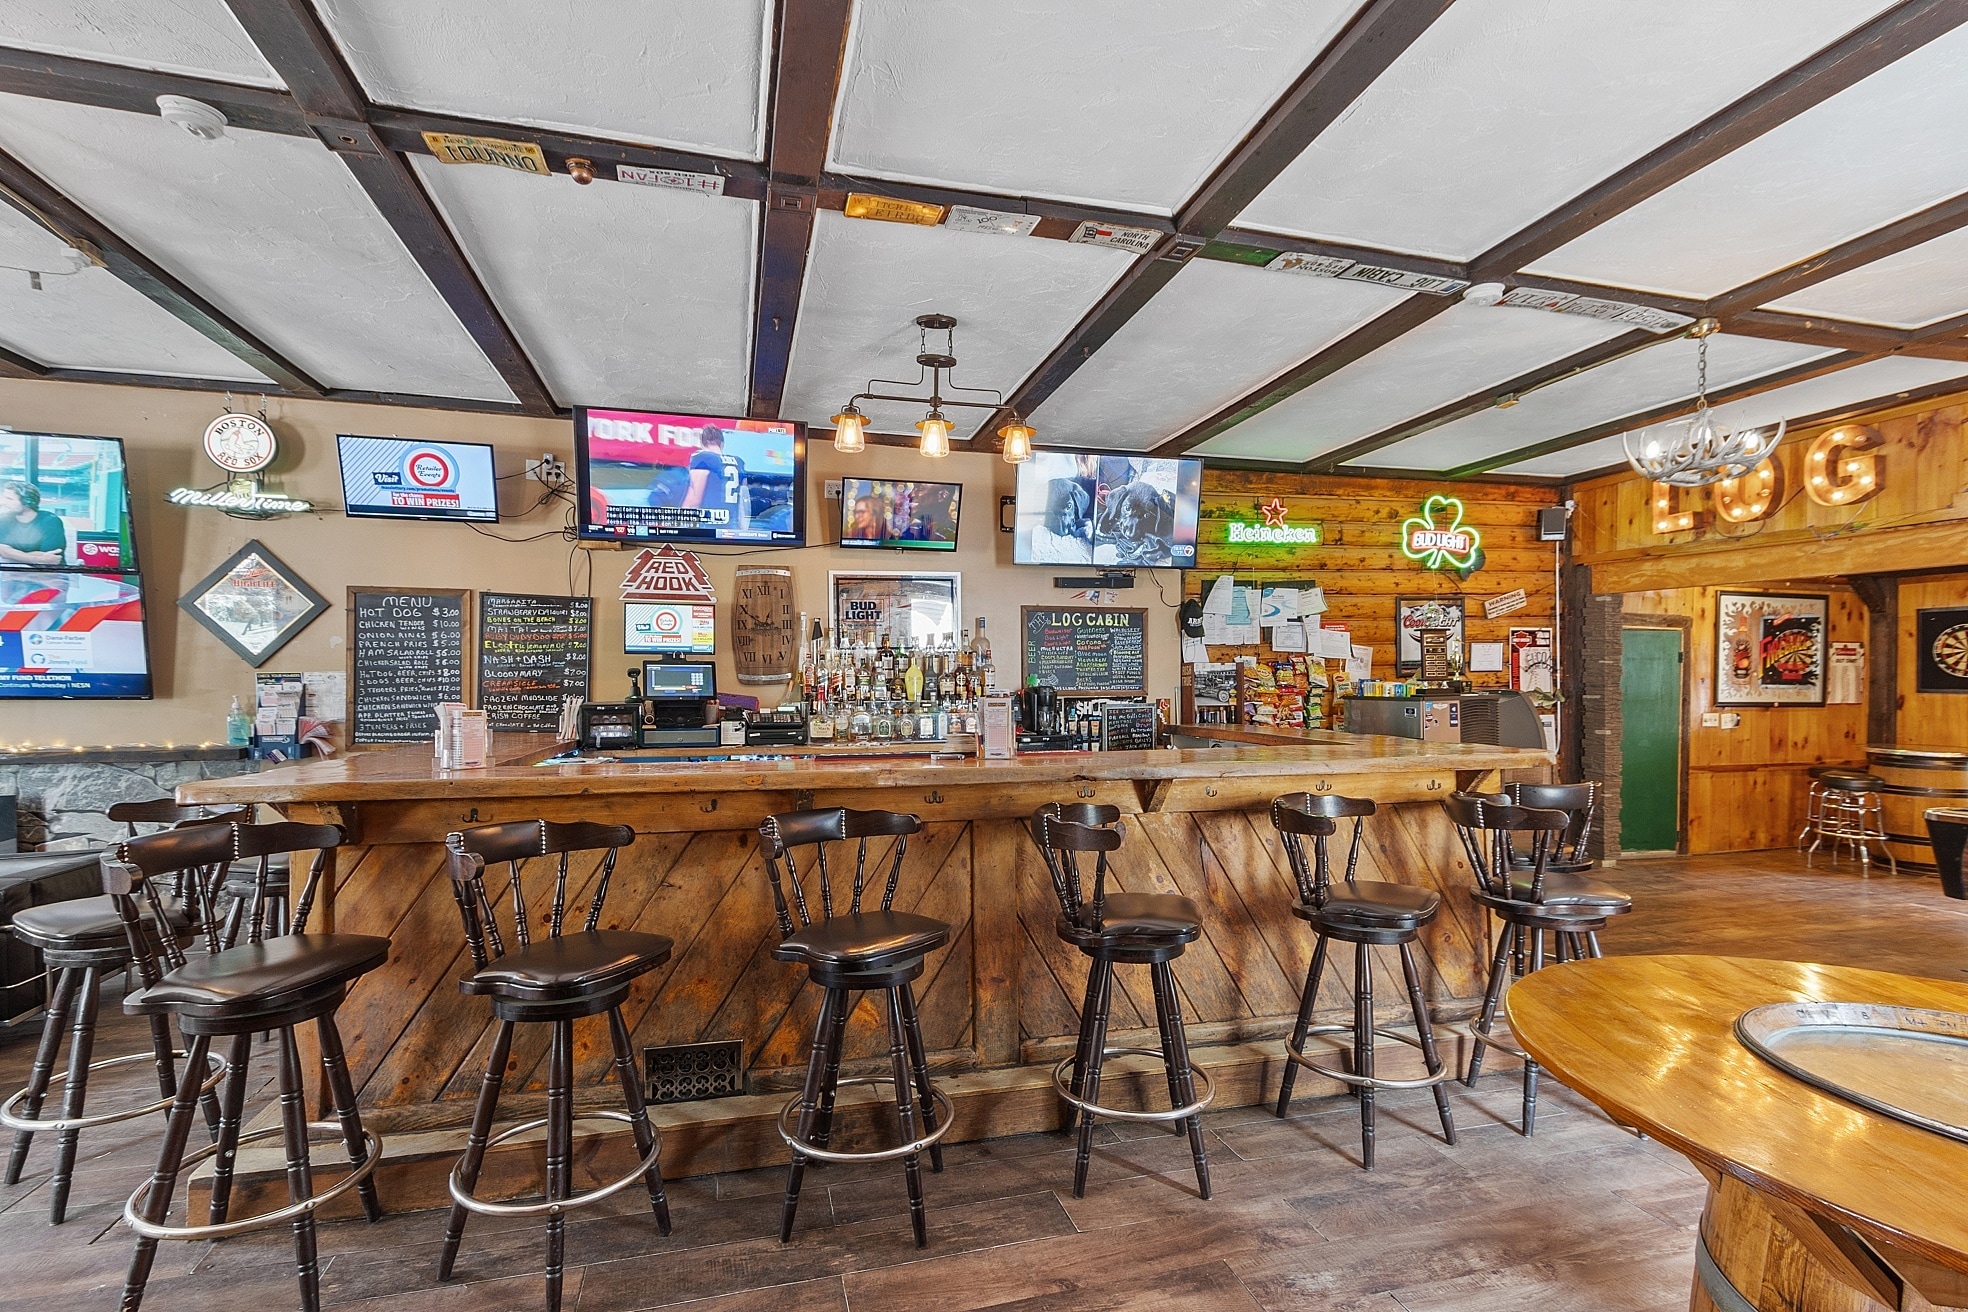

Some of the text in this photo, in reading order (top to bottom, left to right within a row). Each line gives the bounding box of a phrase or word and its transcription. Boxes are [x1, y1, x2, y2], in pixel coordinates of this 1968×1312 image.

[620, 170, 659, 184] FAN
[1120, 231, 1151, 241] NORTH
[1109, 236, 1150, 250] CAROLINA
[1351, 266, 1447, 289] LOG CABIN
[214, 419, 265, 436] BOSTON
[217, 451, 264, 466] RED SOX
[374, 473, 400, 483] Visit
[724, 465, 739, 504] 2
[392, 497, 459, 508] TO WIN PRIZES!
[1229, 522, 1317, 543] Heineken
[1413, 532, 1466, 550] BUD LIGHT
[644, 561, 690, 574] RED
[634, 575, 701, 592] HOOK
[382, 596, 433, 608] MENU
[1488, 590, 1522, 607] WARNING
[850, 601, 877, 611] BUD
[359, 607, 385, 618] HOT
[392, 607, 422, 618] DOG
[845, 610, 882, 621] LIGHT
[358, 620, 396, 629] CHICKEN
[432, 619, 460, 629] $10.00
[1051, 612, 1130, 627] LOG CABIN
[1403, 613, 1428, 629] Coor
[398, 631, 427, 639] RINGS
[431, 631, 461, 640] $6.00
[358, 639, 460, 648] FRENCH FRIES $5.00
[358, 649, 385, 658] HAM
[386, 649, 415, 657] SALAD
[1027, 640, 1036, 664] BEER
[483, 654, 514, 664] NASH
[522, 654, 551, 664] DASH
[484, 669, 519, 678] BLOODY
[519, 669, 543, 677] MARY
[30, 682, 67, 690] Wednesday
[357, 697, 390, 705] CHICKEN
[390, 694, 432, 702] SANDWICH
[521, 694, 559, 702] MUDSLIDE
[357, 703, 391, 711] CHICKEN
[511, 712, 541, 720] COFFEE
